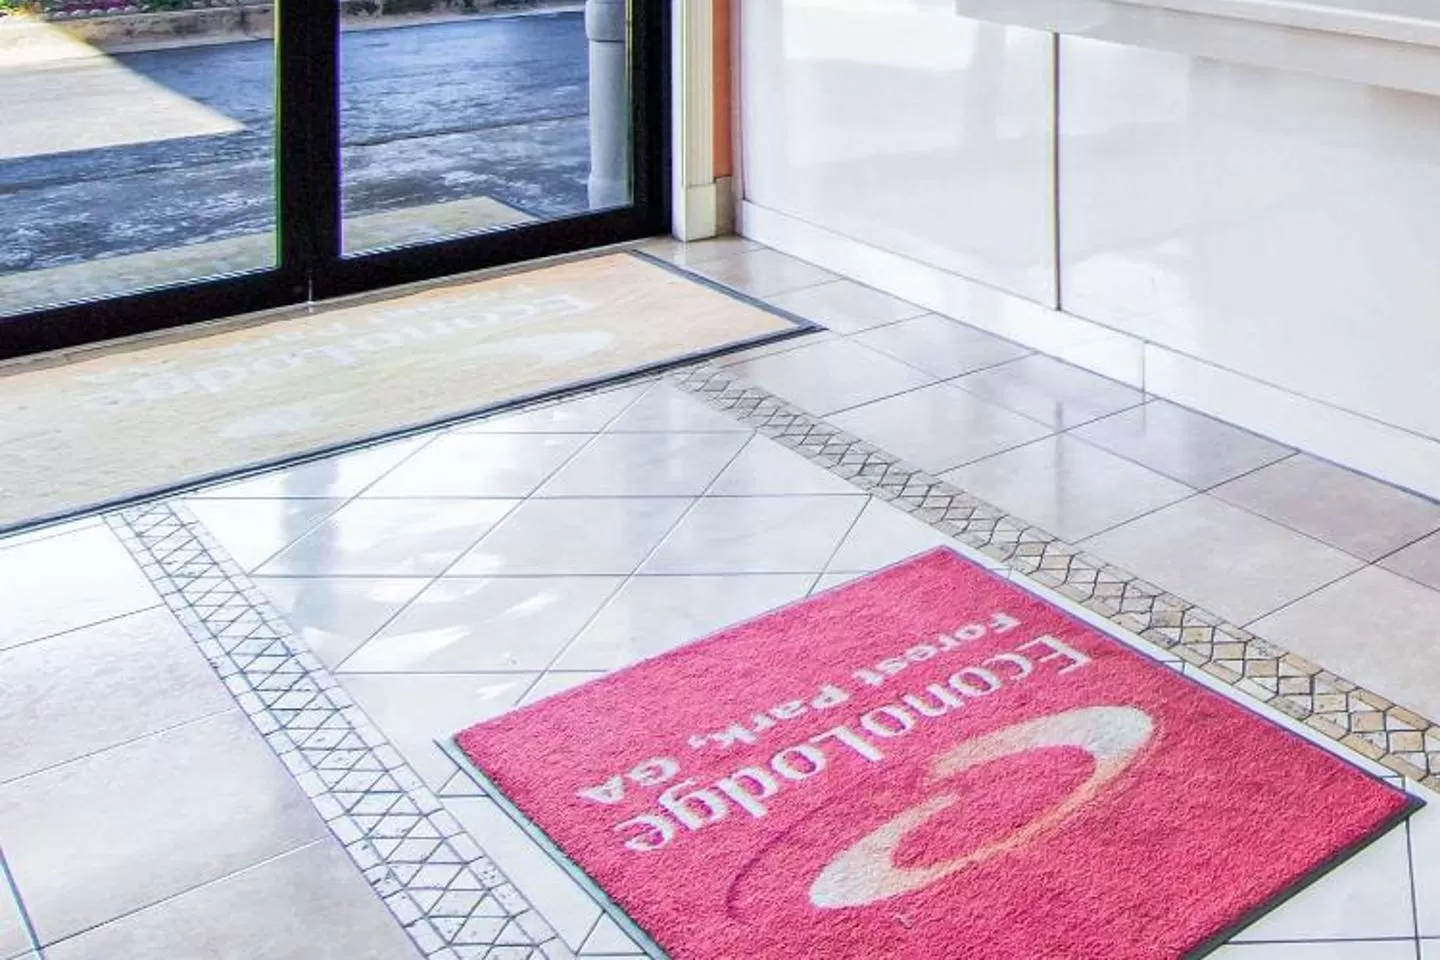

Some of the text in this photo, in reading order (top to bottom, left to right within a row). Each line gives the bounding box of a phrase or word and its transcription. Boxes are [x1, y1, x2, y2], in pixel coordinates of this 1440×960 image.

[576, 612, 1021, 807] Forest Park, GA
[612, 632, 1092, 854] EconoLodge
